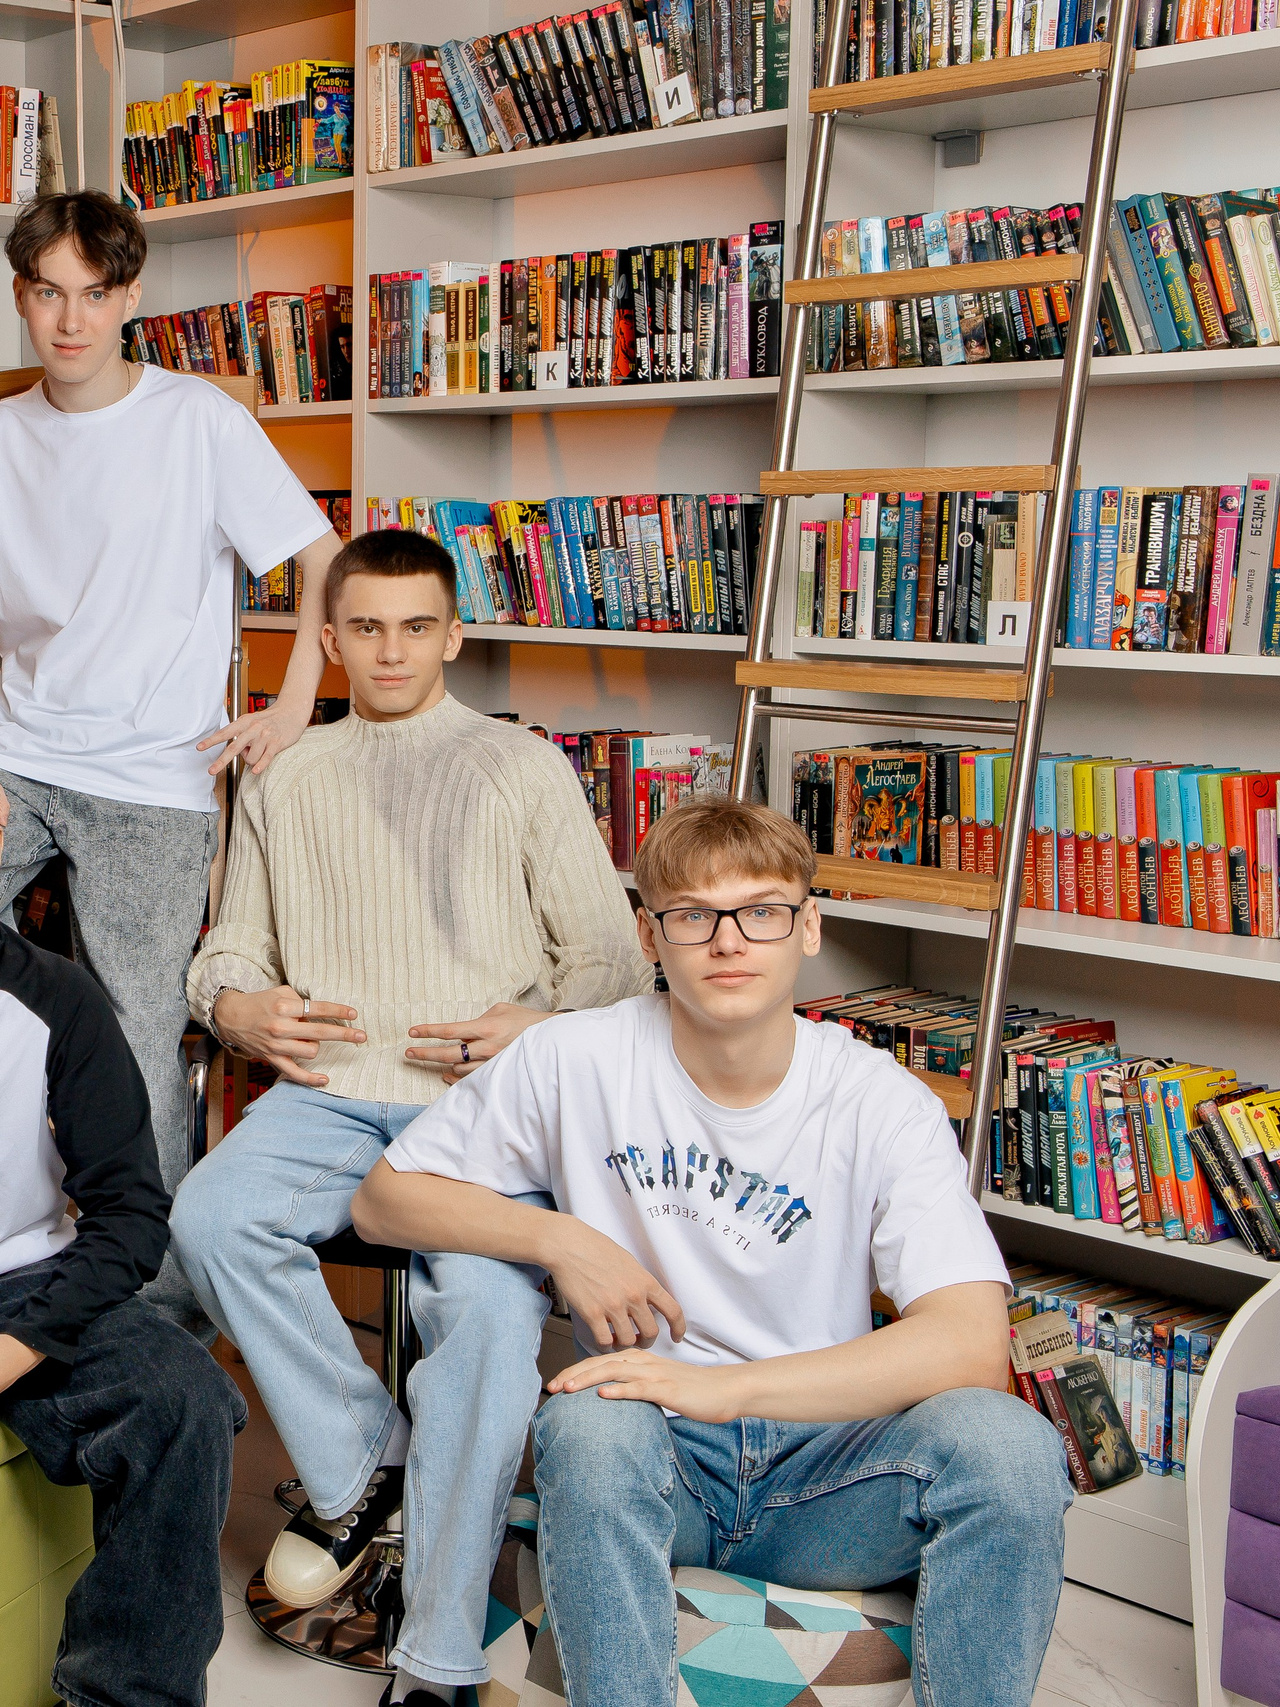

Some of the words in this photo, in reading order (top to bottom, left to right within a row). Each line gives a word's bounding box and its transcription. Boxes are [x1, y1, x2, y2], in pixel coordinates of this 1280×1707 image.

[755, 22, 764, 47] дома
[1047, 19, 1056, 46] КОСТИН
[1146, 7, 1155, 40] ЛЕКАРЬ
[443, 48, 459, 75] ГНЕЗДО
[463, 43, 477, 62] РУСЬ
[753, 49, 765, 84] Черного
[22, 98, 35, 111] В.
[453, 75, 471, 110] БОЛЬШОЕ
[470, 63, 494, 107] ОБАГРЕННАЯ
[754, 85, 763, 110] Тайна
[20, 115, 35, 177] Гроссман
[389, 101, 398, 166] ЗНАМЕНСКАЯ
[1121, 261, 1134, 279] ОЛЕГ
[1034, 299, 1045, 320] УБИТЬ
[1055, 297, 1066, 317] УБИТЬ
[1168, 284, 1179, 308] знаком
[1194, 281, 1221, 338] АНТИТЕРРОР
[756, 306, 768, 373] КУКЛОВОД
[828, 328, 836, 349] ВЕТЕР
[900, 303, 912, 340] НИЖНИЙ
[944, 314, 953, 339] ДВЕРИ
[1016, 314, 1027, 340] ЗЕМЛЯ
[1022, 307, 1034, 338] АНДРЕЯ
[546, 363, 557, 381] К
[570, 338, 583, 379] КАЗАНЦЕВ
[638, 337, 649, 378] КАЗАНЦЕВ
[682, 332, 694, 374] КАЗАНЦЕВ
[370, 377, 379, 391] Иду
[903, 507, 913, 550] ПОЛУШАГЕ
[1084, 493, 1093, 531] ЧУДОВИЩ
[1188, 495, 1201, 535] АНДРЕЙ
[1251, 495, 1266, 536] БЕЗДНА
[666, 557, 676, 570] 12
[715, 549, 726, 571] БОЙ
[1144, 502, 1165, 585] ТРАНКВИЛИУМ
[1213, 528, 1225, 571] ЛАЗАРЧУК
[590, 549, 603, 600] КАЛУГИН
[878, 547, 892, 598] ГРАФИНЯ
[937, 564, 949, 586] СТАС
[1081, 541, 1092, 595] УСПЕНСКИЙ
[1176, 539, 1187, 592] УСПЕНСКИЙ
[1184, 539, 1199, 593] ЛАЗАРЧУК
[718, 577, 730, 622] ВЕЧНЫЙ
[827, 559, 839, 618] КУЛИКОВА
[970, 594, 980, 618] ВОЙНЕ
[1093, 560, 1114, 637] ЛАЗАРЧУК
[998, 615, 1016, 636] Л
[1100, 786, 1108, 827] ПОСЛЕДНИЙ
[1042, 841, 1053, 900] ЛЕОНТЬЕВ
[1064, 844, 1075, 904] ЛЕОНТЬЕВ
[1084, 847, 1094, 907] ЛЕОНТЬЕВ
[1102, 848, 1113, 909] ЛЕОНТЬЕВ
[1126, 851, 1138, 912] ЛЕОНТЬЕВ
[1146, 856, 1157, 912] ЛЕОНТЬЕВ
[1169, 855, 1180, 917] ЛЕОНТЬЕВ
[1195, 857, 1207, 920] ЛЕОНТЬЕВ
[1214, 859, 1227, 922] ЛЕОНТЬЕВ
[1007, 1054, 1017, 1108] ЛИТВИНОВЫ
[1019, 1109, 1033, 1168] ЛЮБОСТАЙ
[1054, 1132, 1065, 1155] РОТА
[1136, 1136, 1146, 1163] ДЕРЖИТ
[1174, 1130, 1191, 1177] Луганцева
[1211, 1119, 1234, 1162] ЛОГУНОВА
[1259, 1120, 1277, 1151] Логунова
[1056, 1156, 1068, 1207] ПРОКЛЯТАЯ
[1138, 1163, 1150, 1191] БАТАРЕЯ
[1230, 1163, 1247, 1189] ЕЛЕНА
[1025, 1331, 1073, 1360] ЛЮБЕНКО
